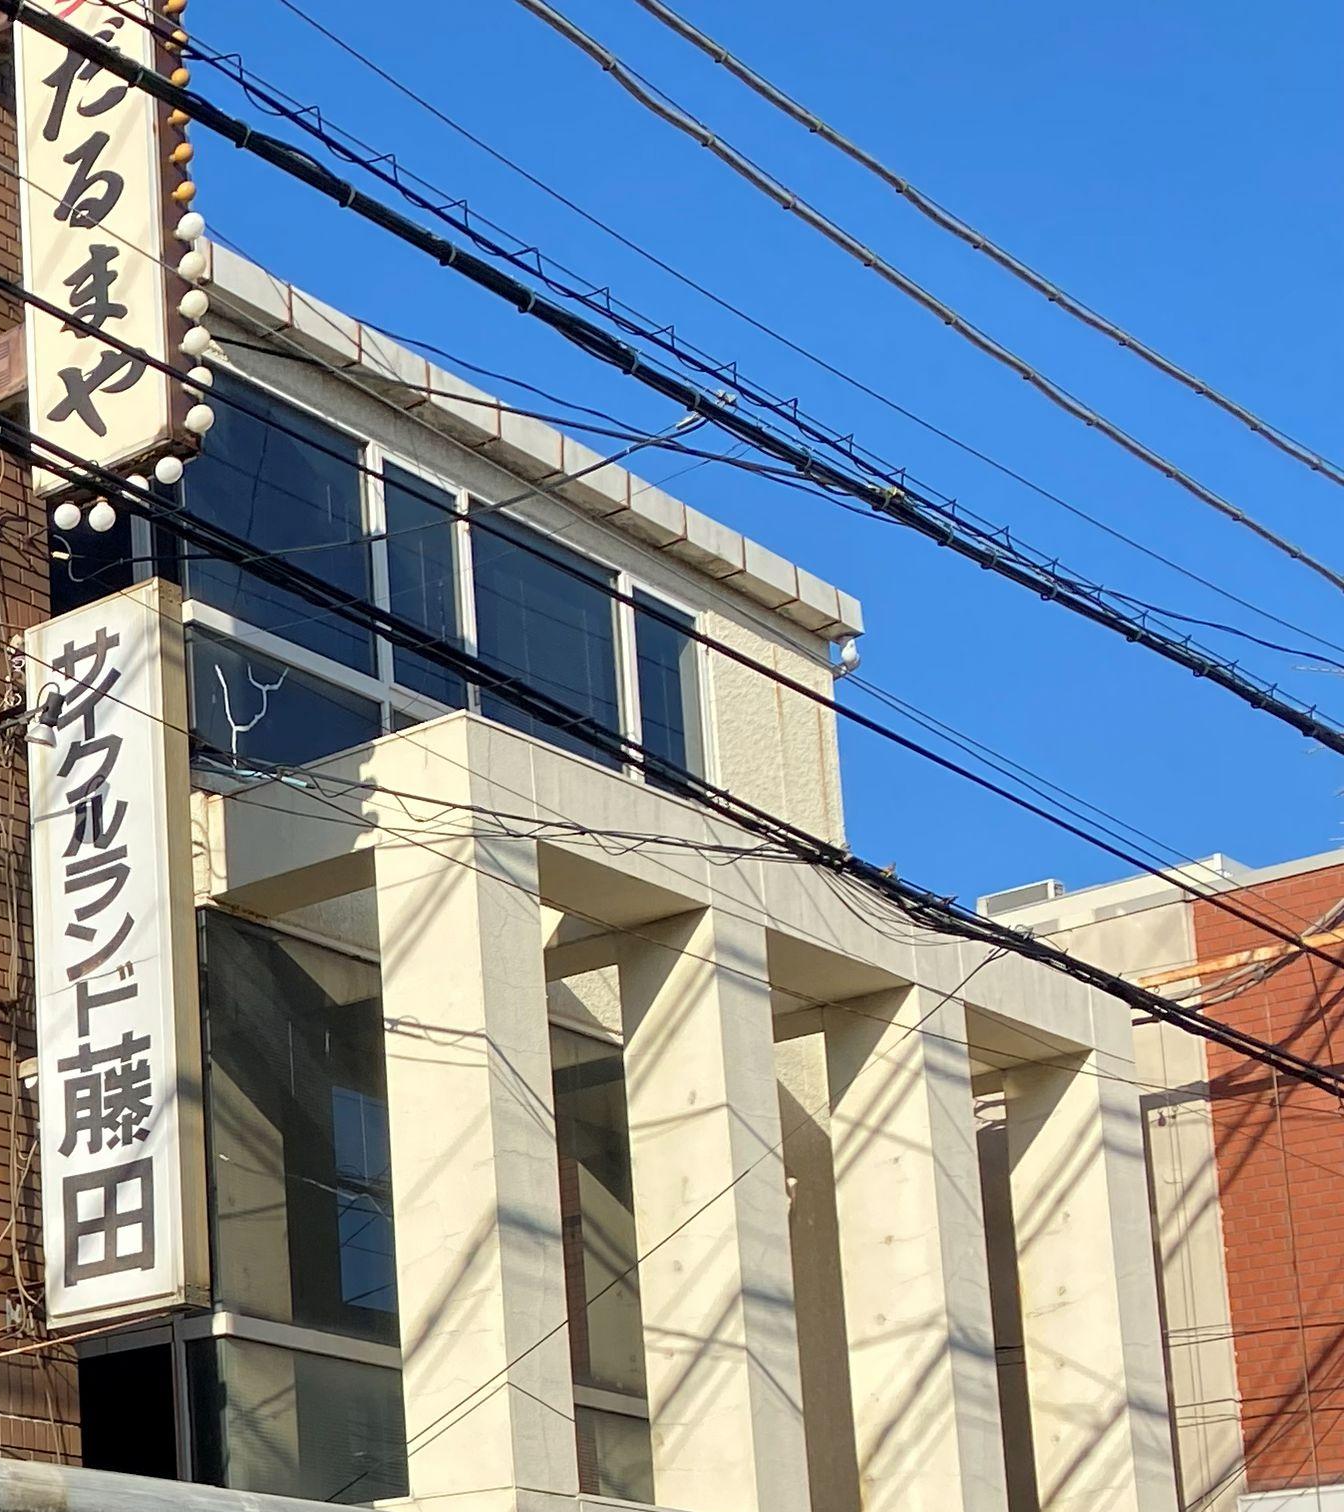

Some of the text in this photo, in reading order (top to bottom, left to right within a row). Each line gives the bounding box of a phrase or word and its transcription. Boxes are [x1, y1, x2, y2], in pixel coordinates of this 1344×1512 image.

[43, 16, 148, 437] だるまや
[52, 625, 155, 1289] サイクルランド藤田
